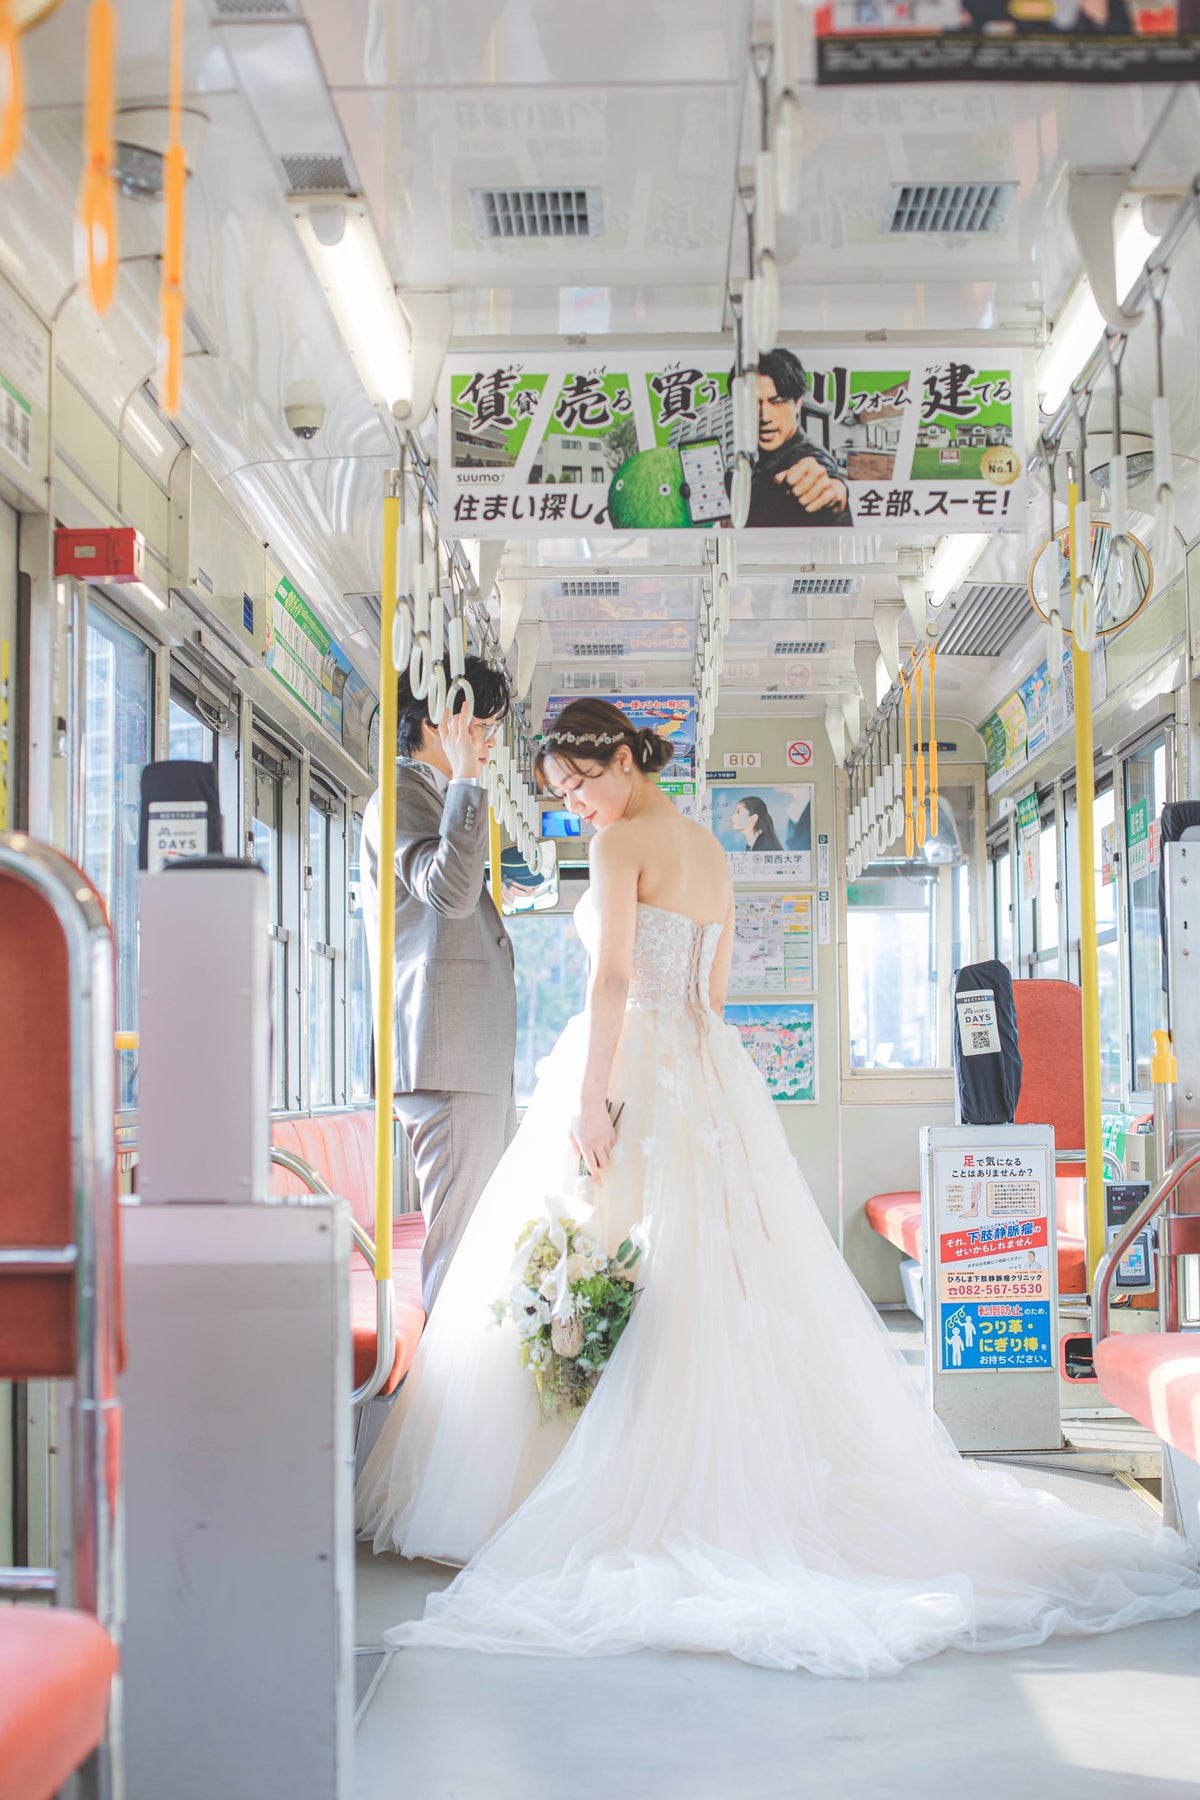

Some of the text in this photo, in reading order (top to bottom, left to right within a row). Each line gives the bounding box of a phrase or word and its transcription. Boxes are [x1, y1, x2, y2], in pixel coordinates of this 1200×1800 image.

[556, 375, 632, 429] 売る
[651, 368, 717, 424] 買う
[922, 362, 1012, 419] 建てる
[988, 460, 1013, 474] No.1
[456, 473, 500, 483] suumo
[857, 490, 1011, 517] 全部、スーモ!
[729, 755, 756, 765] 810
[158, 839, 197, 849] DAYS
[764, 854, 803, 864] 関西大学
[965, 1013, 991, 1023] DAYS
[963, 1155, 1022, 1167] 足で気になる
[952, 1168, 1033, 1178] ことはありませんか?
[954, 1237, 1033, 1257] せいかもしれません
[958, 1283, 1042, 1295] 082-567-5530
[979, 1336, 1048, 1352] にぎり棒を
[979, 1355, 1048, 1365] お持ちください。
